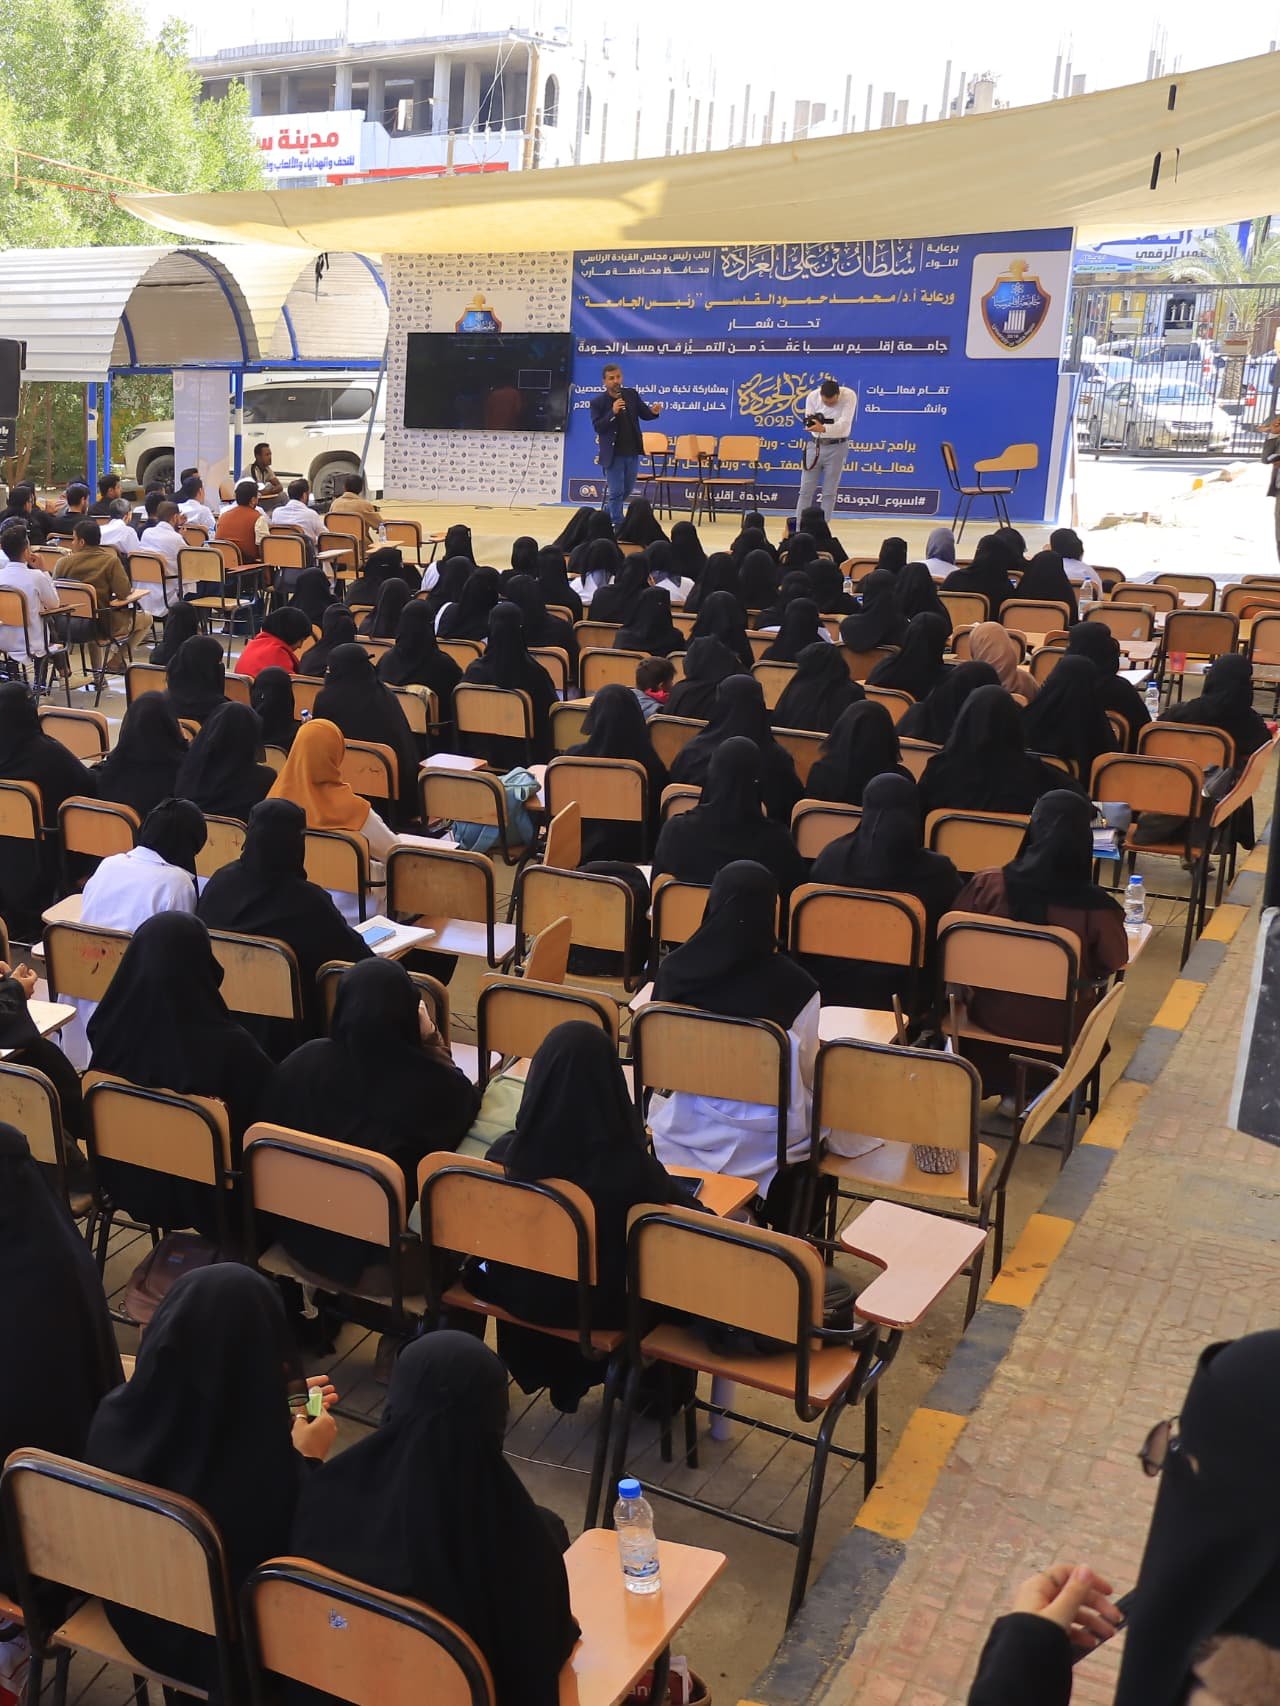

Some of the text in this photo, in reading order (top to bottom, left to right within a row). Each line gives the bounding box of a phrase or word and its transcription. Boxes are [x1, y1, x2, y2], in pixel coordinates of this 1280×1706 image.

[278, 128, 339, 154] مدينة
[926, 243, 960, 254] برعاية
[1135, 246, 1177, 262] الرقمي
[611, 252, 639, 262] القيادة
[640, 252, 667, 263] مجلس
[669, 251, 692, 262] رئيس
[925, 258, 959, 269] اللواء
[612, 266, 662, 276] محافظة
[663, 265, 710, 275] محافظ
[704, 292, 775, 311] القدسي
[776, 292, 828, 308] حمود
[920, 289, 956, 306] ورعاية
[727, 317, 821, 331] تحت شعار
[621, 341, 655, 354] مسار
[657, 342, 682, 355] في
[727, 342, 757, 354] من
[846, 340, 895, 354] إقليم
[897, 340, 948, 354] جامعة
[658, 385, 671, 395] من
[672, 385, 692, 395] نخبة
[692, 385, 729, 396] بمشاركة
[866, 385, 950, 397] تقام فعاليات
[702, 402, 727, 412] خلال
[754, 416, 795, 427] 2025
[847, 440, 886, 453] تدريبية
[888, 437, 917, 453] برامج
[860, 461, 915, 474] فعاليات
